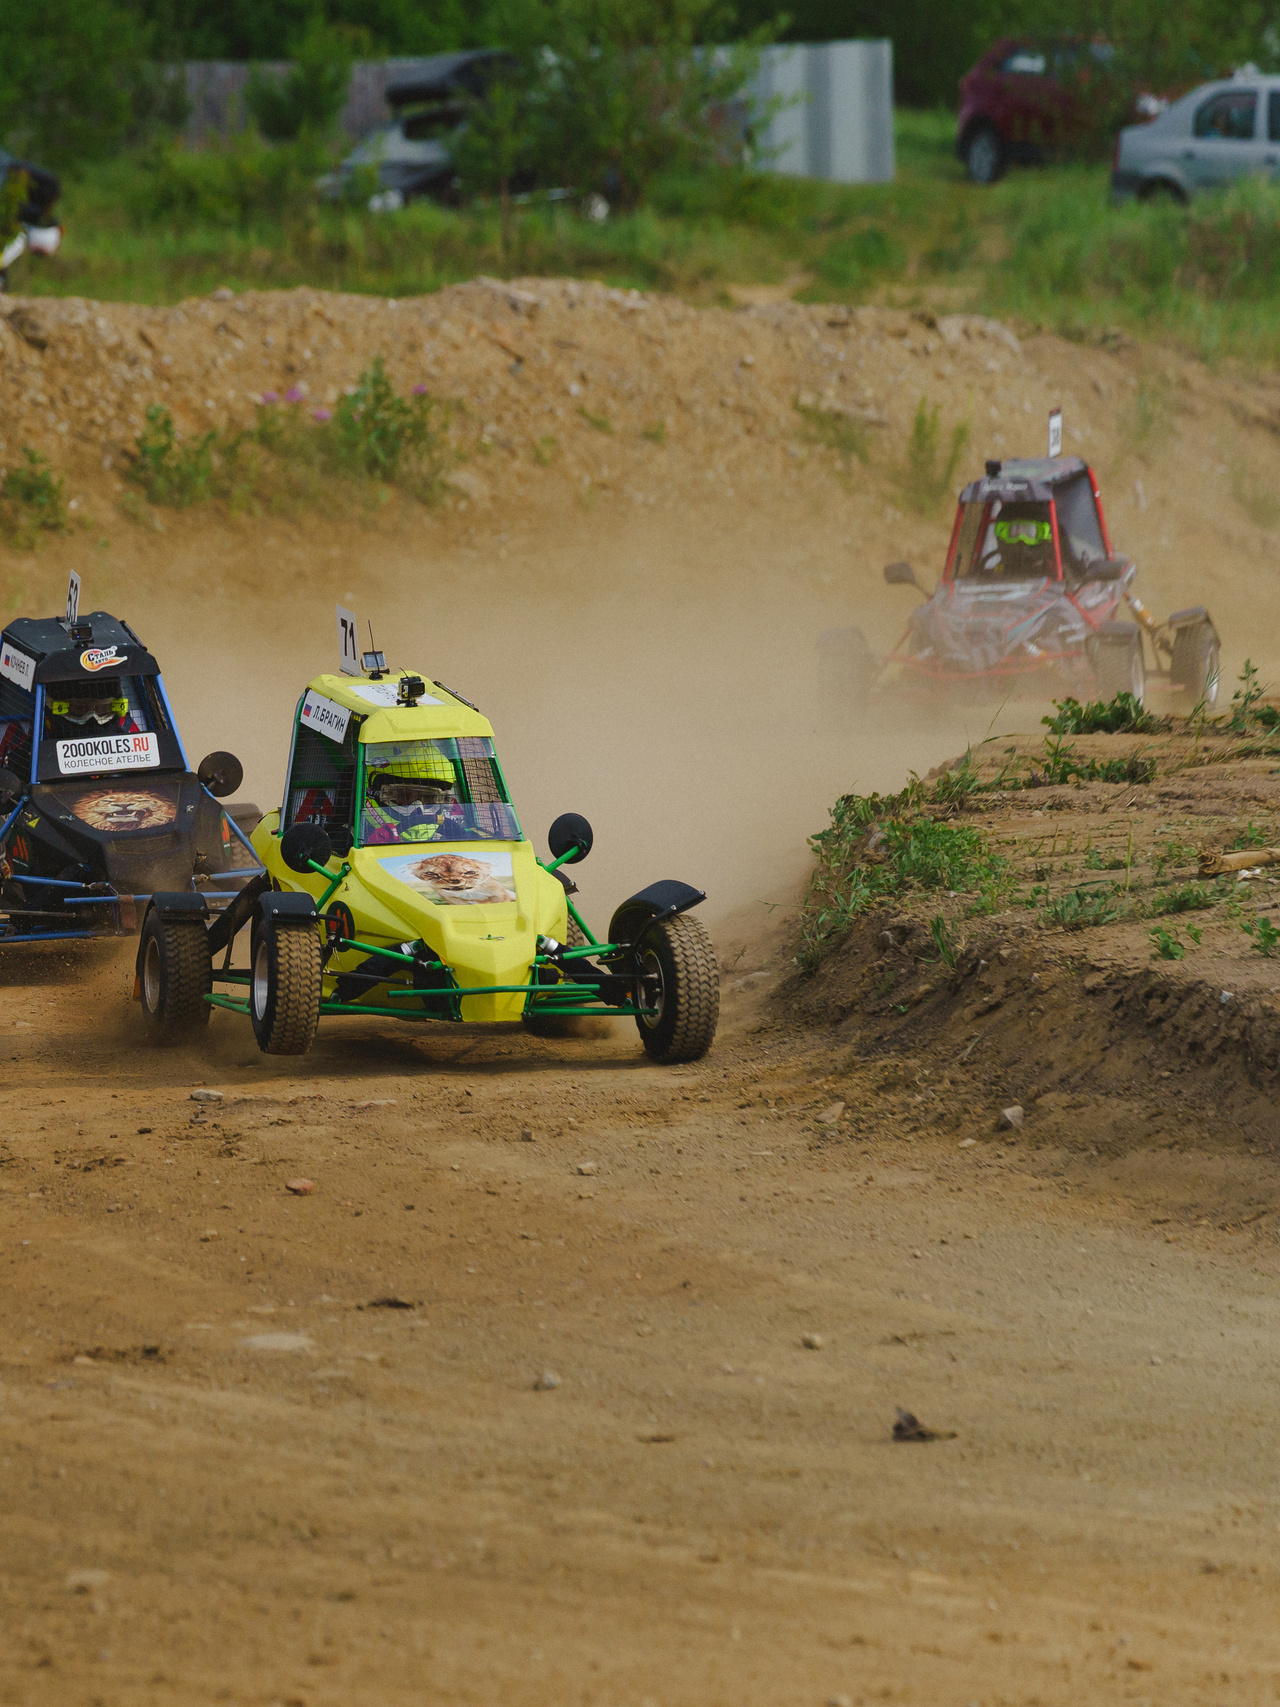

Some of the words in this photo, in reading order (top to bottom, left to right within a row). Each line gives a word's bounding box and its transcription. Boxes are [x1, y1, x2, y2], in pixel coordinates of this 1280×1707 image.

[340, 617, 356, 661] 71
[312, 704, 346, 733] Л.БРАГИН
[62, 737, 150, 759] 2000KOLES.RU
[64, 757, 114, 769] КОЛЕСНОЕ
[115, 753, 152, 764] АТЕЛЬЕ
